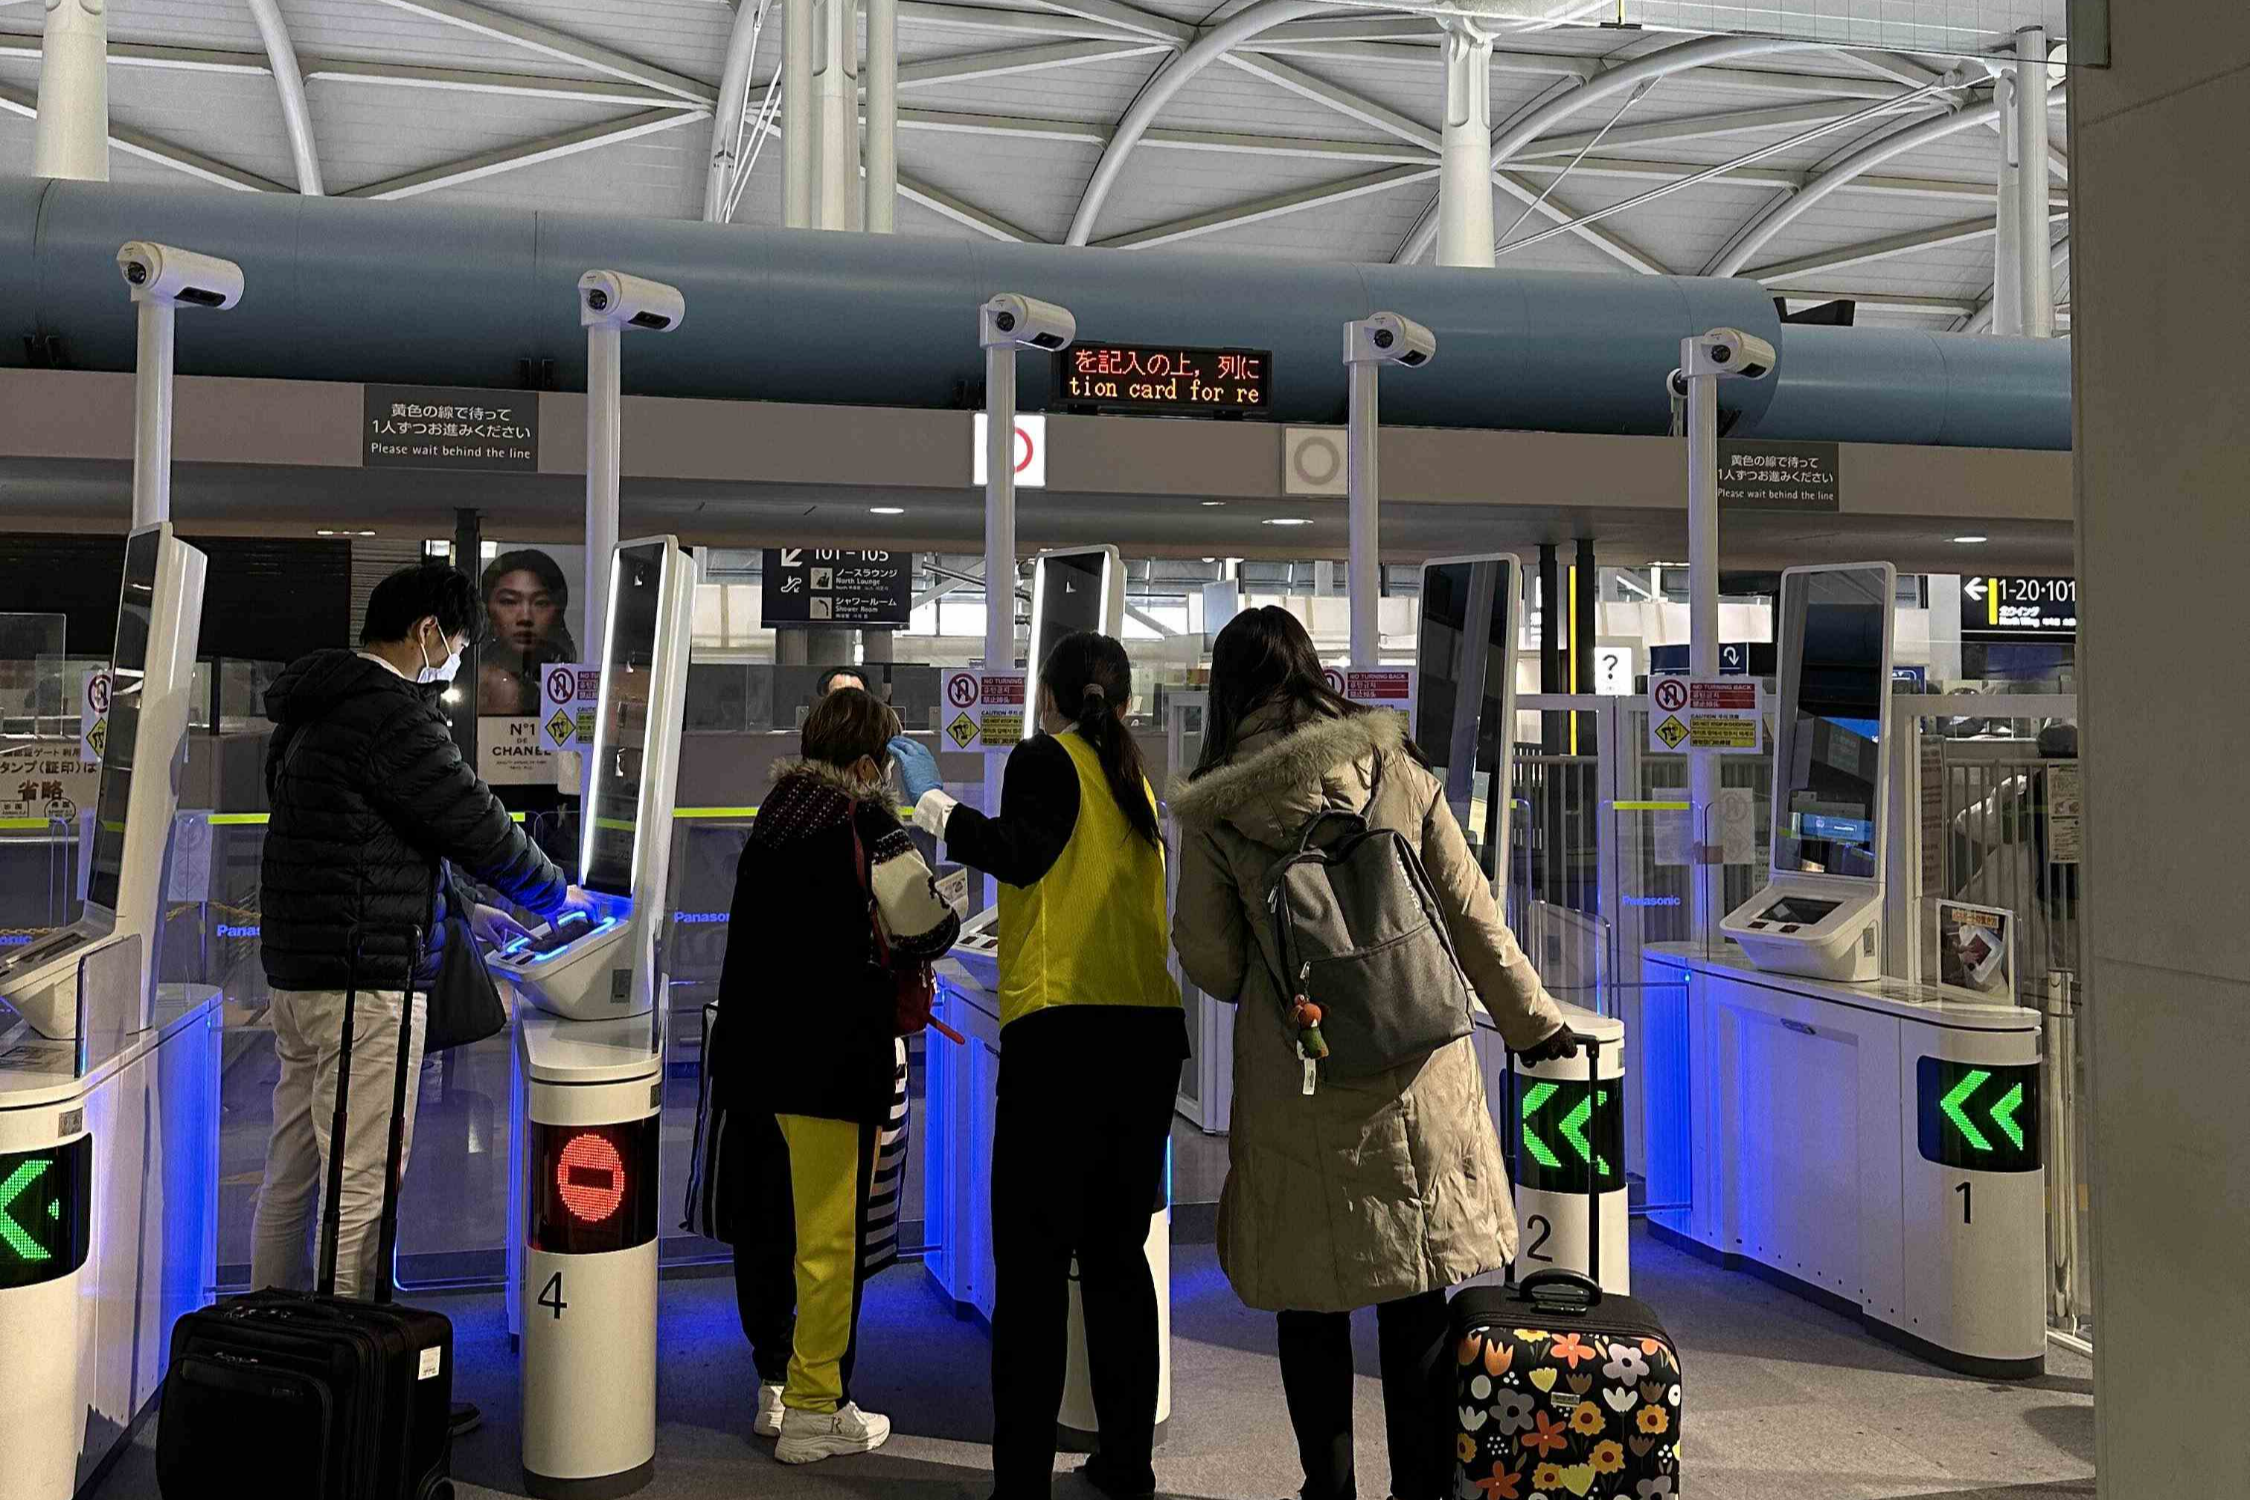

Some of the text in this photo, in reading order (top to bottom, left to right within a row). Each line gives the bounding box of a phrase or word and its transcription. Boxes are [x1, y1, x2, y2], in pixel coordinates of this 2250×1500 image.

[1070, 376, 1259, 403] tion card for re
[392, 404, 512, 422] 黄色の線で待って
[372, 420, 532, 439] 1人ずつお進みください
[371, 442, 531, 459] Please wait behind the line
[1731, 454, 1819, 468] 黄色の線で待って
[1718, 469, 1834, 483] 1人ずつお進みください
[1718, 488, 1834, 501] Please wait behind the line
[836, 568, 898, 578] ノースラウンジ
[856, 578, 880, 586] Lounge
[836, 598, 898, 606] シャワールーム
[18, 780, 64, 800] 省略
[1622, 895, 1681, 906] Panasonic
[1955, 1182, 1971, 1224] 1
[1527, 1214, 1553, 1262] 2
[538, 1272, 568, 1320] 4
